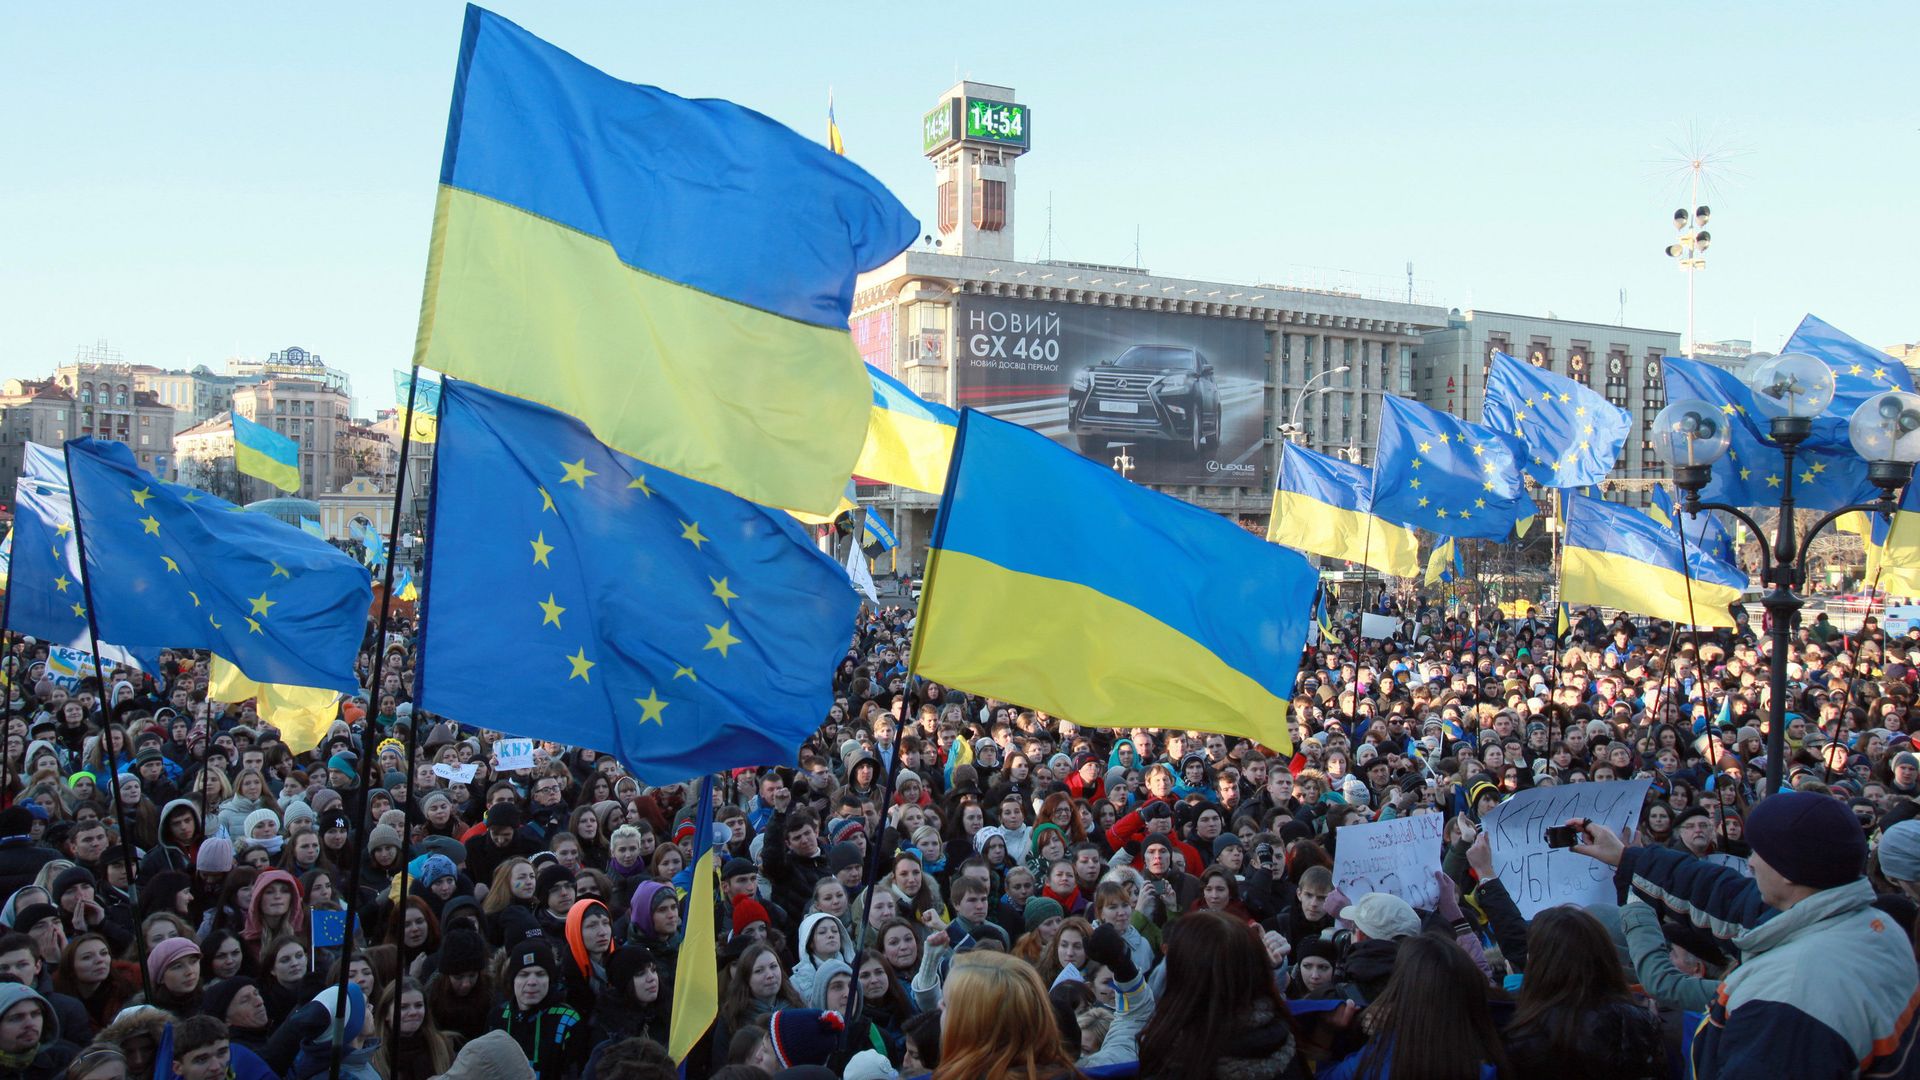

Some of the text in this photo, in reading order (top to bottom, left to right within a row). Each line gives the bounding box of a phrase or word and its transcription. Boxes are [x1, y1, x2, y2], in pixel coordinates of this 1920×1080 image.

[971, 107, 1022, 136] 14:54
[970, 310, 1060, 336] НОВИЙ
[970, 334, 1060, 361] GX 460
[970, 360, 1059, 371] НОВИЙ ДОСВІД ПЕРЕМОГ
[1220, 463, 1255, 471] LEXUS
[501, 742, 530, 757] КНУ
